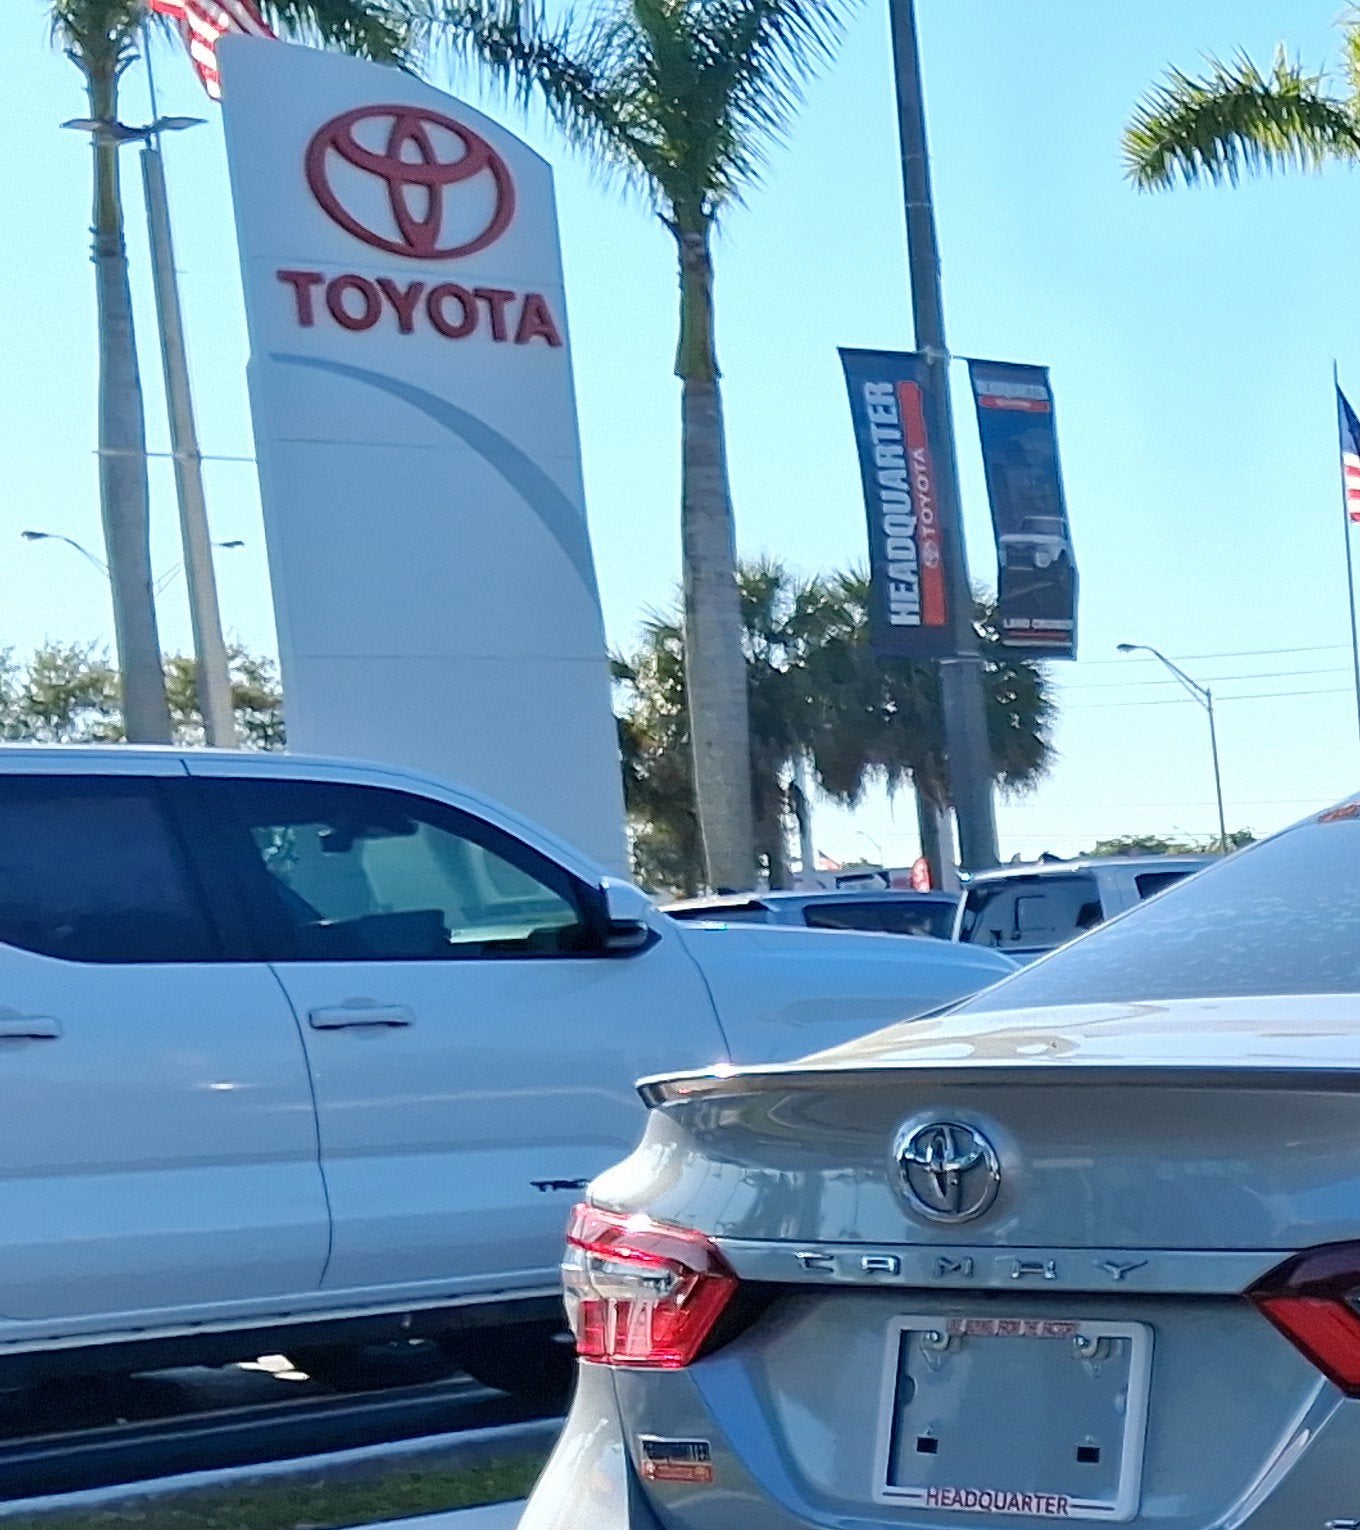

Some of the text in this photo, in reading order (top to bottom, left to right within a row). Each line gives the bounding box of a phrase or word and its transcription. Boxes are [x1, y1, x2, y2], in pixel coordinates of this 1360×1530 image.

[276, 269, 563, 347] TOYOTA
[862, 380, 921, 627] HEADQUARTER
[912, 448, 940, 538] TOYOTA
[794, 1250, 1149, 1281] CAMRY
[926, 1486, 1069, 1516] HEADQUARTER
